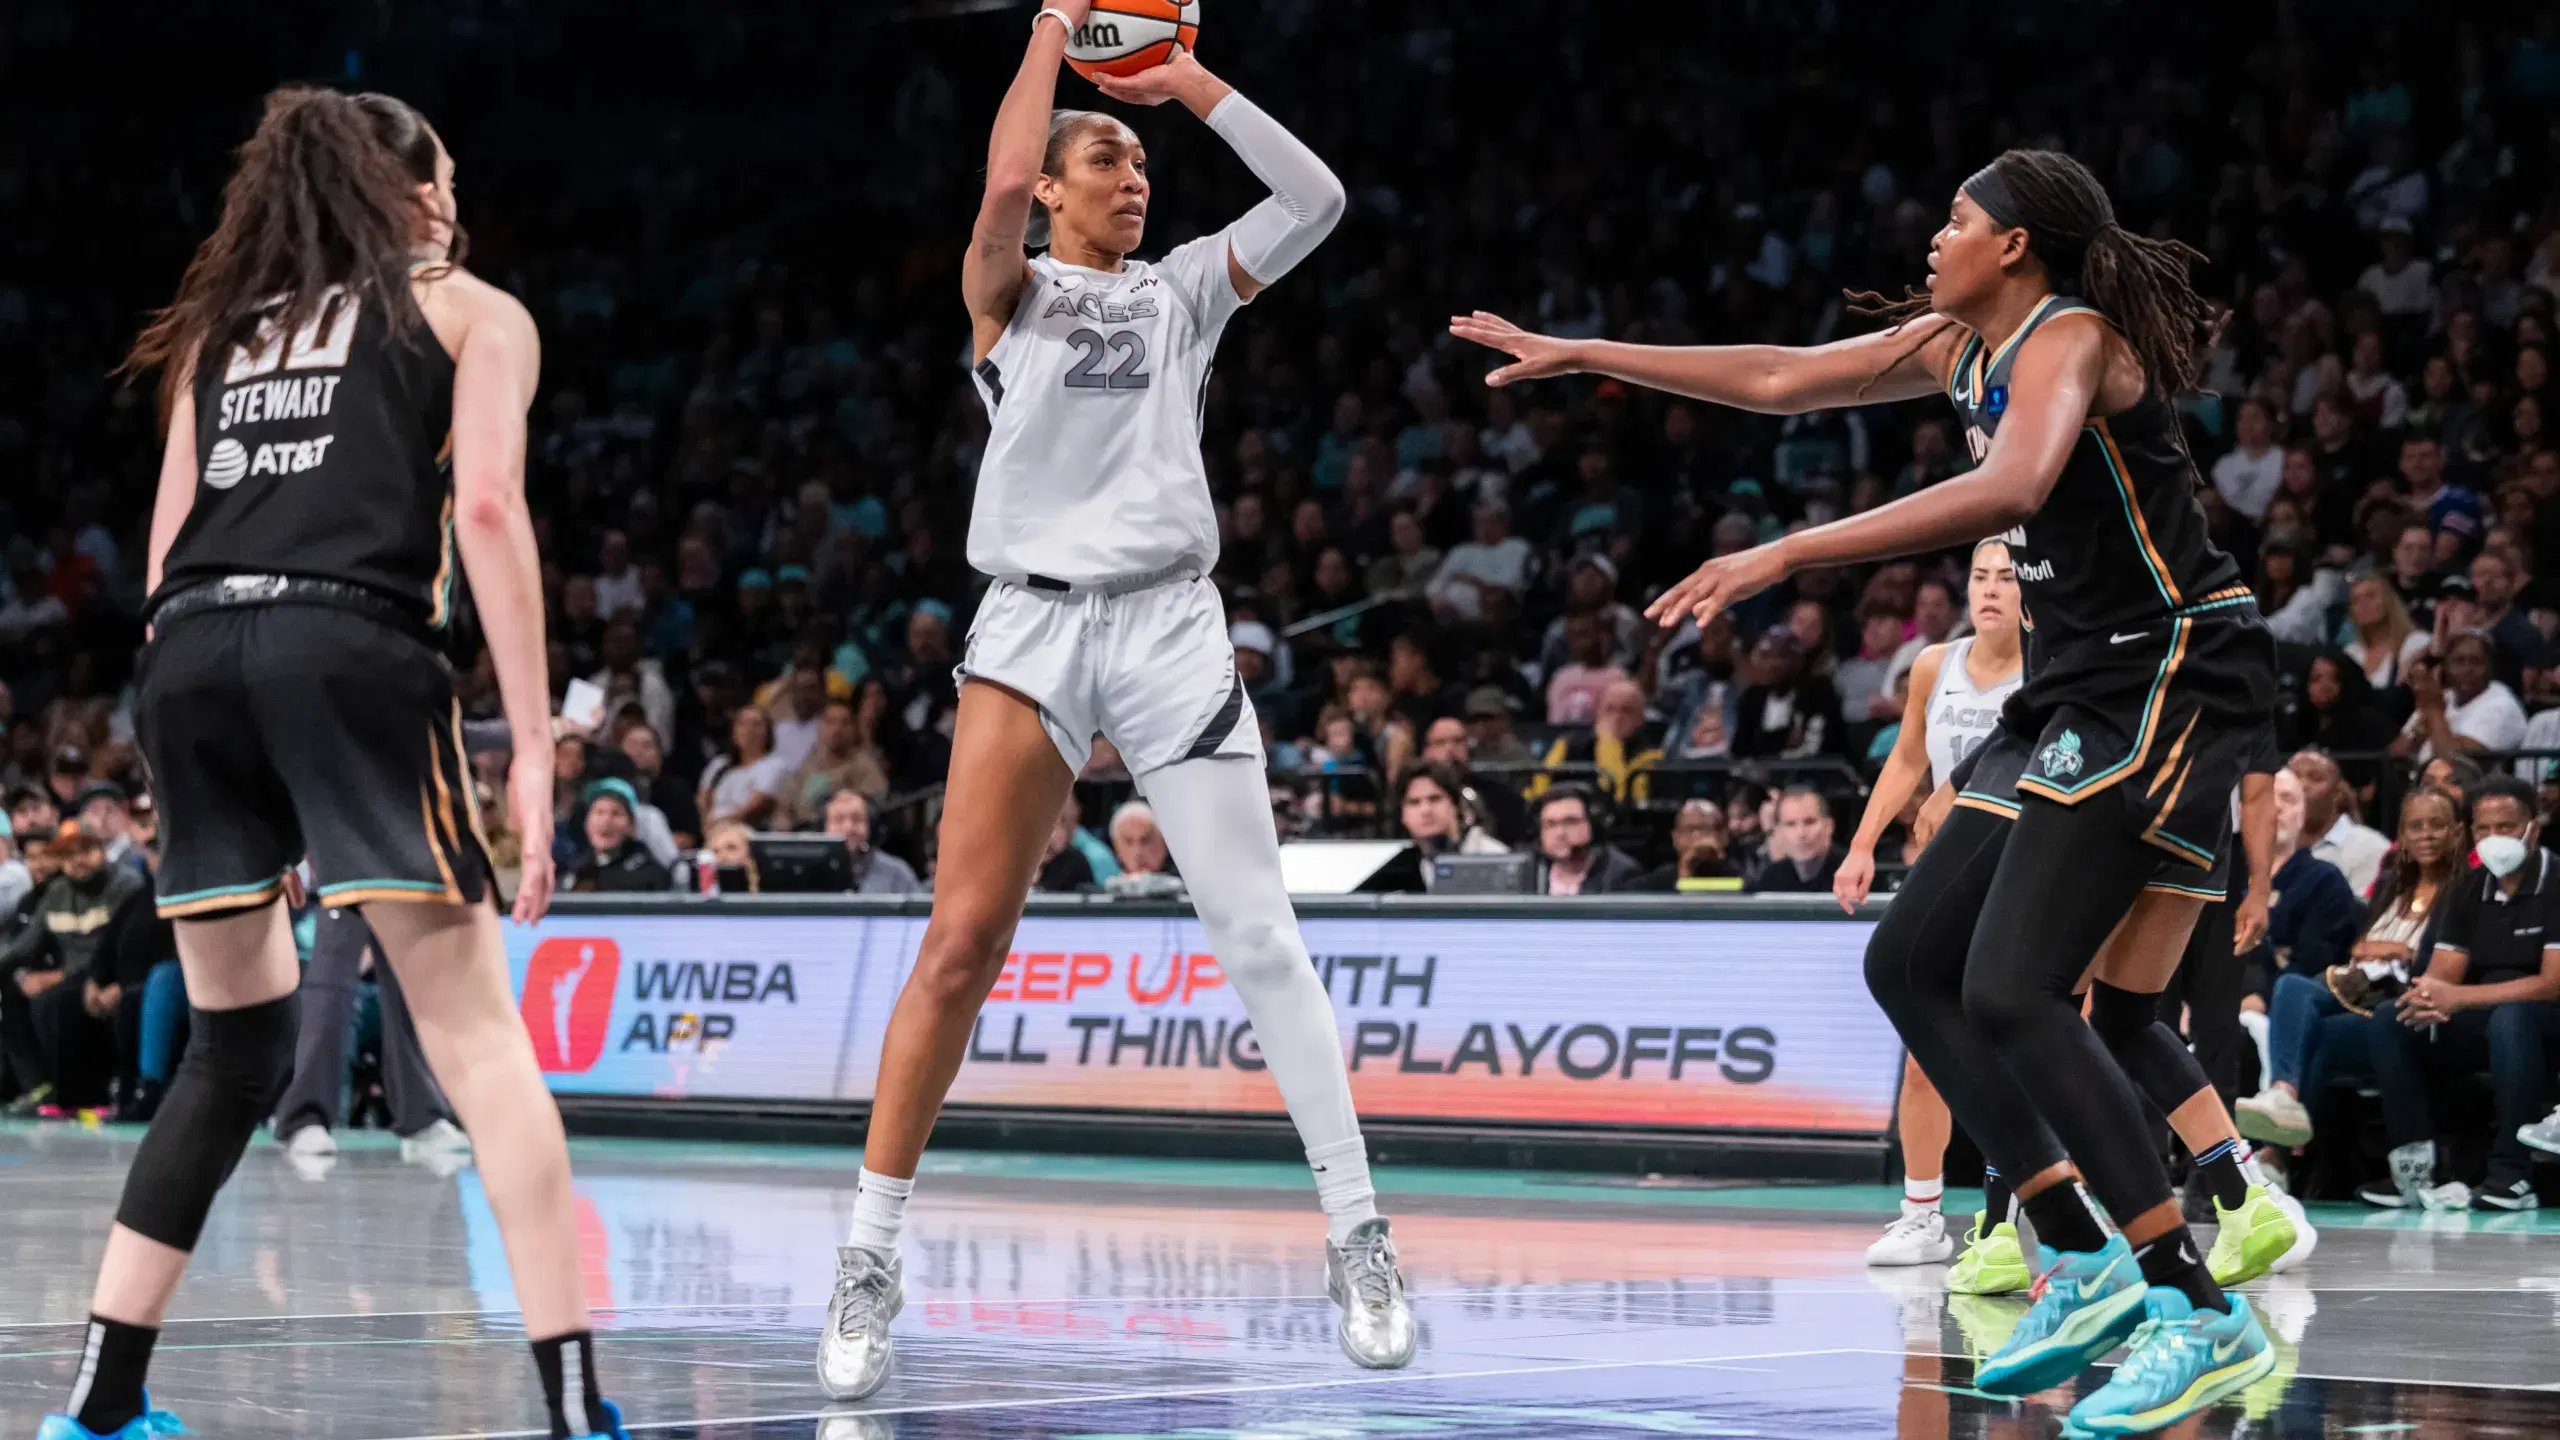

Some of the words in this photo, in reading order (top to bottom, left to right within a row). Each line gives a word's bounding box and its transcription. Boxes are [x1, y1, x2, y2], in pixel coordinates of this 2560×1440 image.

[1129, 278, 1159, 294] ally
[1043, 292, 1159, 323] ACES
[1065, 328, 1150, 389] 22
[218, 376, 341, 431] STEWART
[250, 434, 335, 476] AT&T
[1936, 705, 1999, 729] ACE
[634, 961, 798, 1004] WNBA
[985, 953, 1112, 1002] EEP
[1127, 953, 1228, 1006] UP
[1311, 954, 1437, 1007] ITH
[619, 1012, 736, 1054] APP
[967, 1013, 1047, 1064] LL
[1068, 1015, 1268, 1071] THING
[1350, 1021, 1778, 1084] PLAYOFFS
